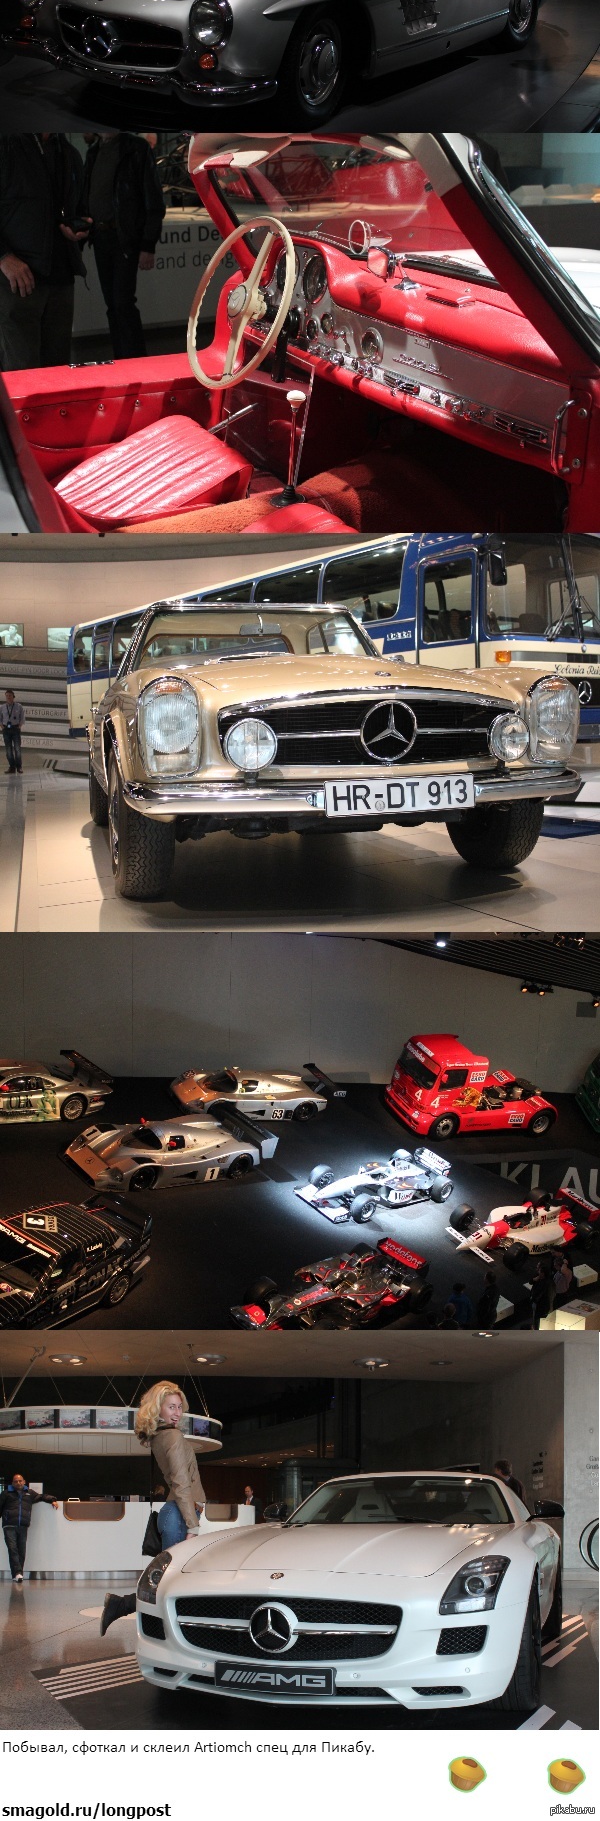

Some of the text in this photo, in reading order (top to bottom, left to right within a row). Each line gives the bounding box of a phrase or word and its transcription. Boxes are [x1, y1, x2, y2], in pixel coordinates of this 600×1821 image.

[159, 227, 190, 244] und
[156, 252, 186, 270] and
[428, 779, 467, 806] 913
[431, 1096, 440, 1109] 4
[271, 1108, 284, 1120] 63
[208, 1168, 216, 1181] 1
[384, 1239, 423, 1268] vodafone
[251, 1672, 326, 1688] AMG
